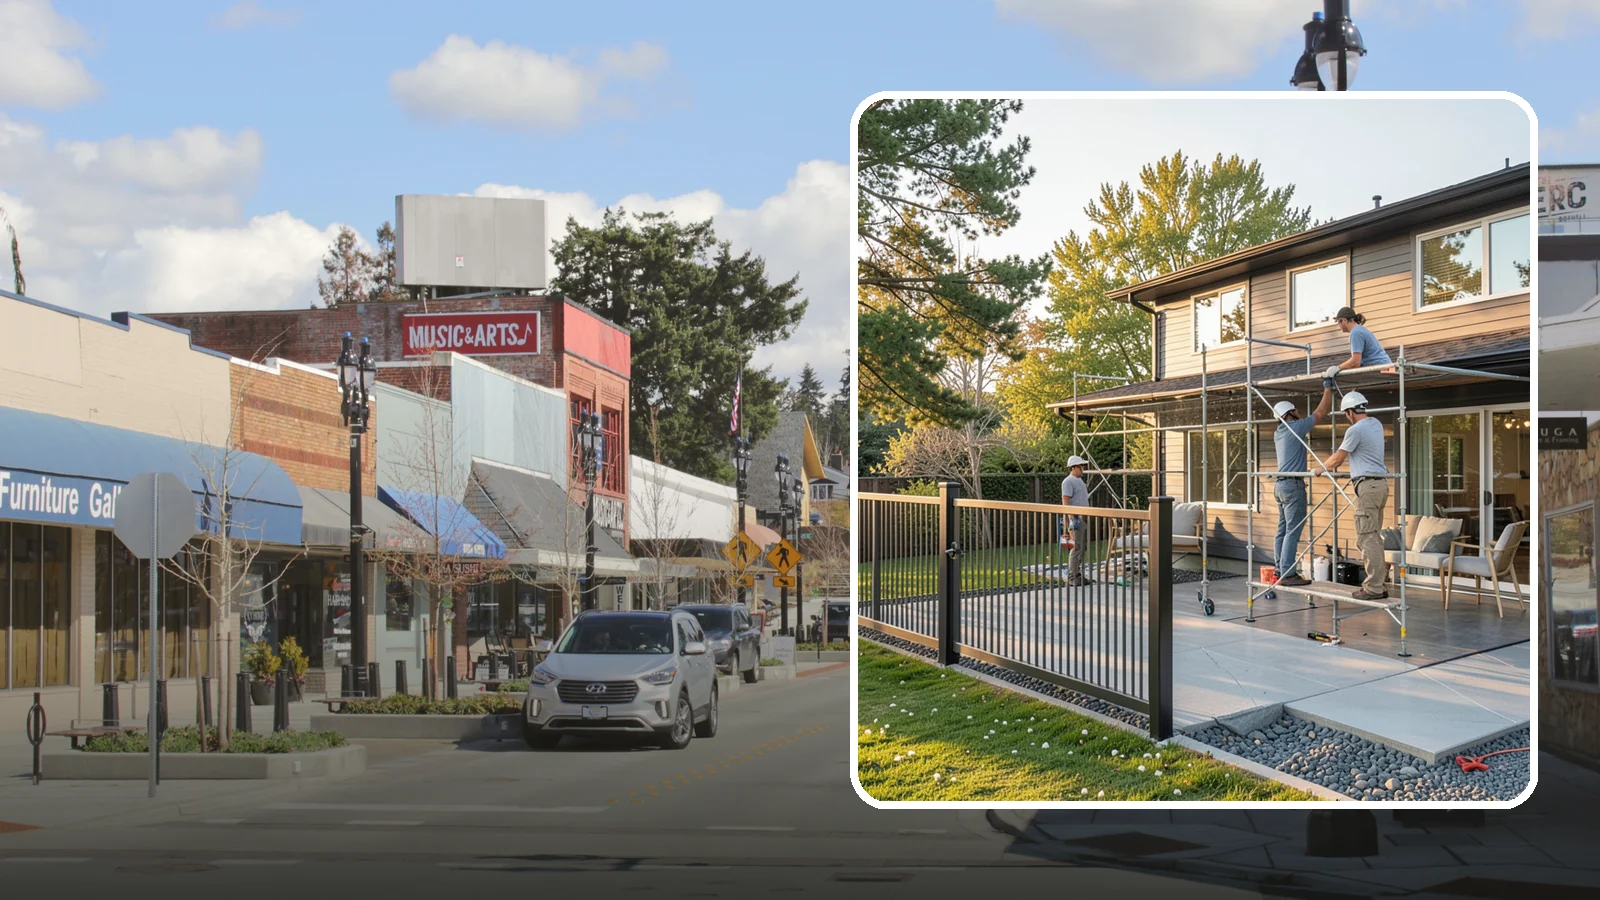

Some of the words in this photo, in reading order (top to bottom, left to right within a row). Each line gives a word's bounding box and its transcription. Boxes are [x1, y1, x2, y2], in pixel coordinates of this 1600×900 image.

[409, 323, 519, 349] MUSIC&ARTS
[1540, 428, 1577, 436] UGA
[0, 471, 79, 515] Furniture
[453, 563, 480, 574] SUSHI
